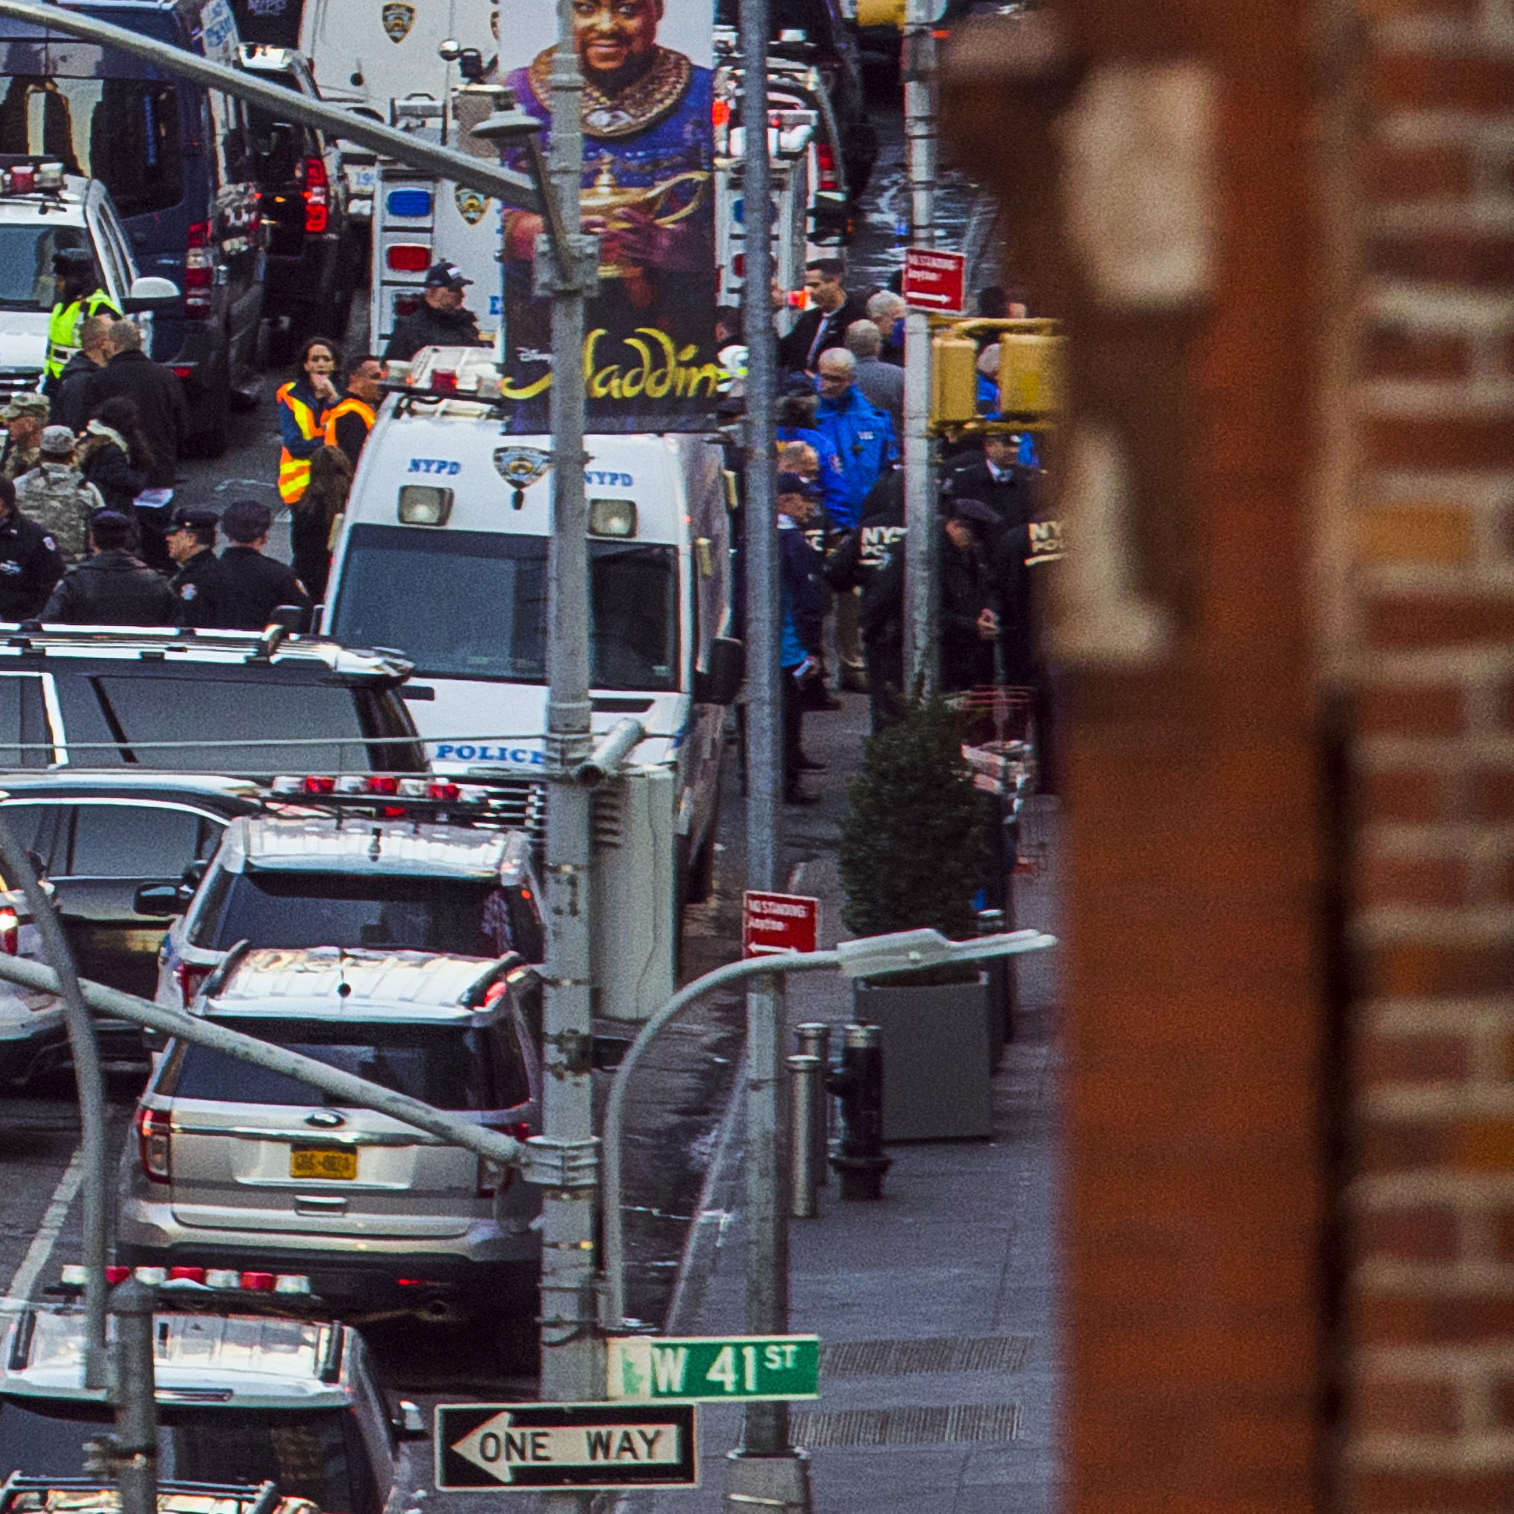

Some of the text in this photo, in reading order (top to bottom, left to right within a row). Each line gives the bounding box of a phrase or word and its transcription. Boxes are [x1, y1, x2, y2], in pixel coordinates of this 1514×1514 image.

[502, 326, 722, 400] laddin
[407, 458, 634, 488] NYPD NYPD
[652, 1344, 798, 1393] W 41 ST
[478, 1426, 664, 1462] ONE WAY
